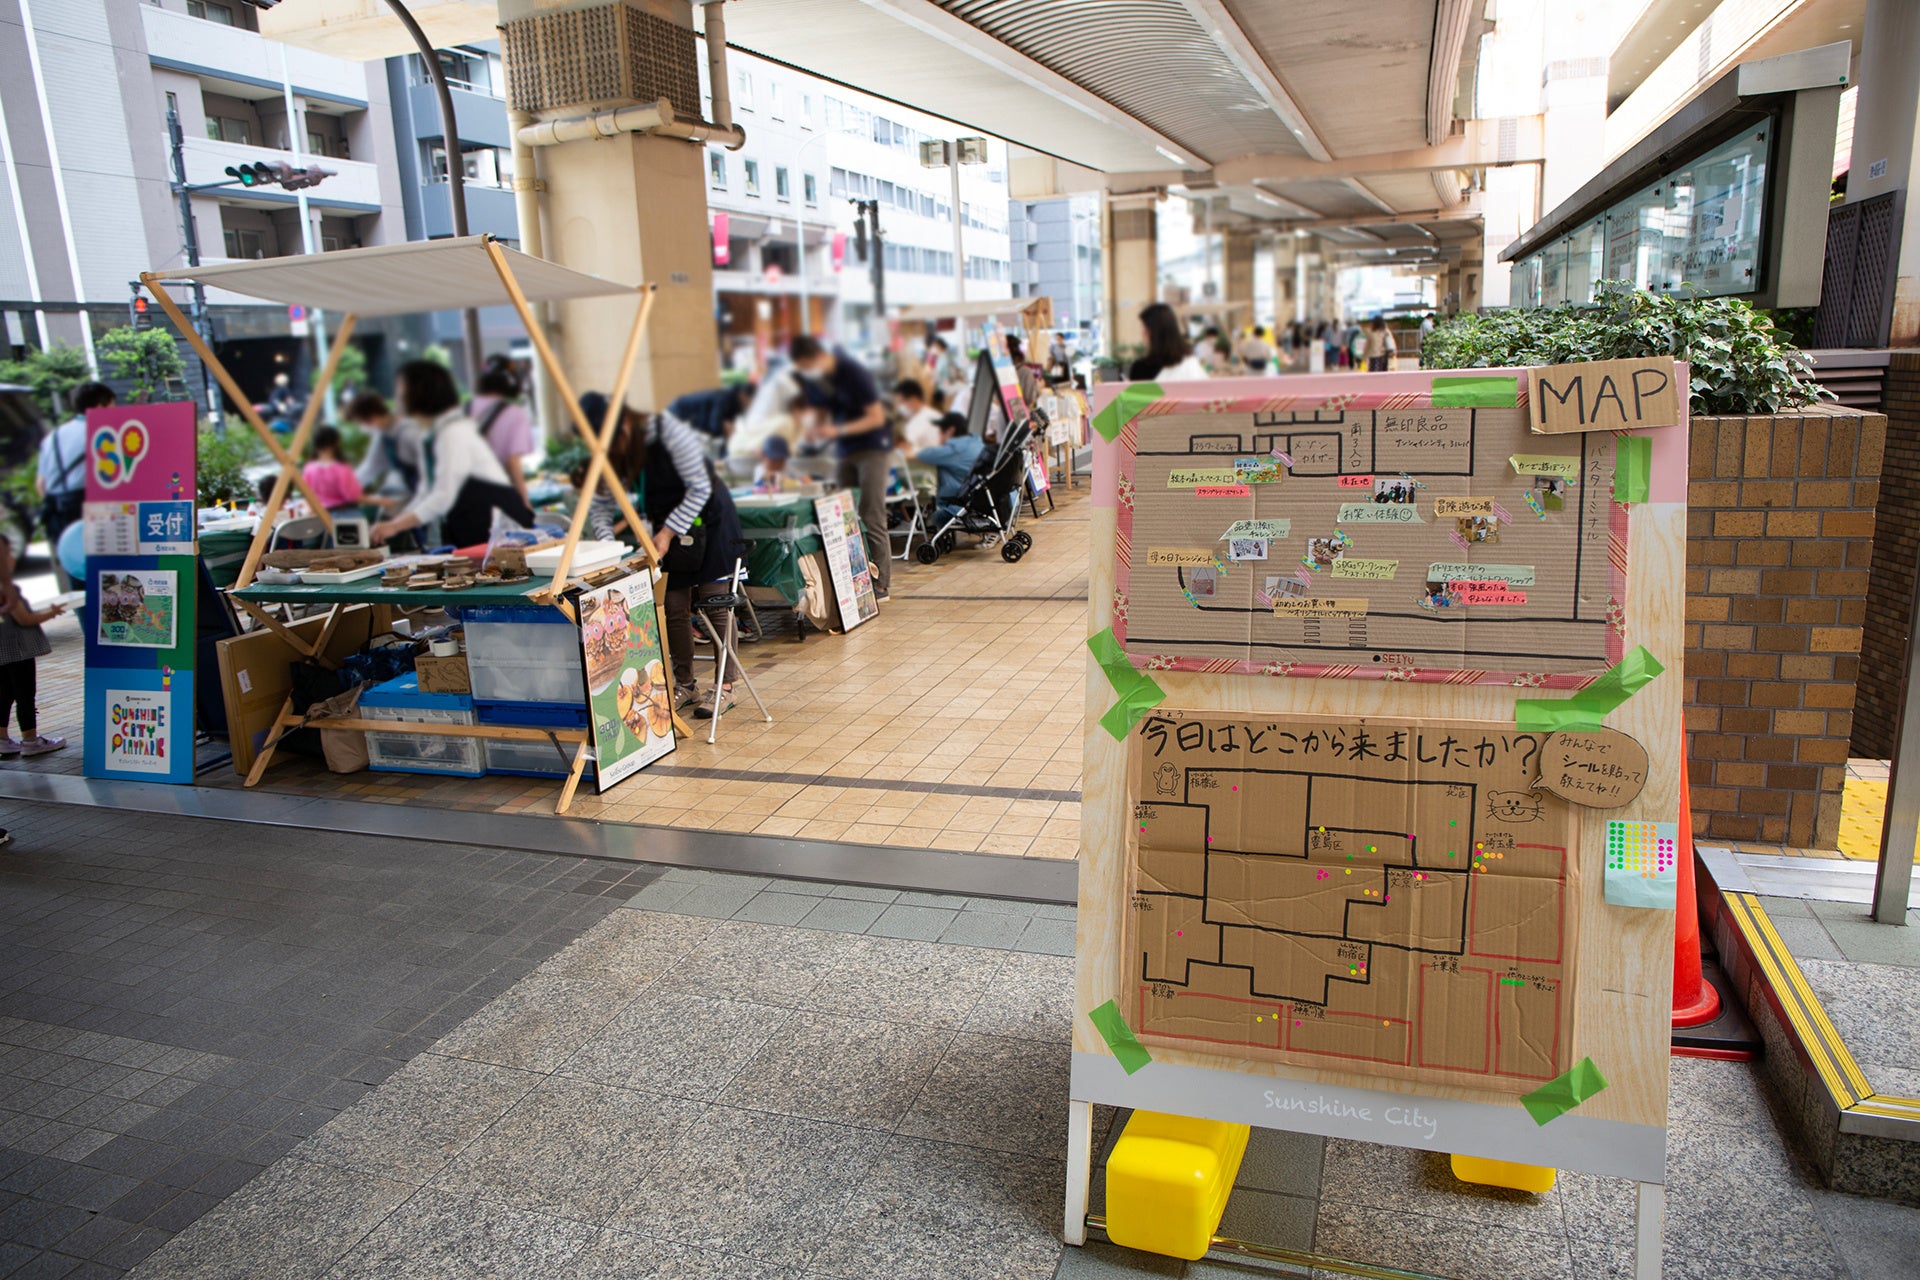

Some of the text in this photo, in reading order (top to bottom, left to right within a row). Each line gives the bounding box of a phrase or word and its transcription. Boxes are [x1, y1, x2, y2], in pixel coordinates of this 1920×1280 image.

[1539, 368, 1669, 424] MAP
[1384, 415, 1448, 433] 無印良品
[1302, 454, 1335, 464] カイザー
[1340, 478, 1370, 486] 現在地
[1586, 445, 1607, 541] バスターミナル
[1438, 499, 1493, 513] 冒険遊び場
[1343, 508, 1398, 521] お笑い体験
[147, 512, 183, 536] 受付
[1149, 551, 1213, 564] 母の日アレンジメント
[110, 625, 129, 634] 300
[1382, 653, 1415, 665] SEIYU
[112, 703, 165, 727] SUNSHINE
[121, 722, 155, 738] CITY
[599, 717, 620, 735] 300
[1139, 716, 1538, 776] 今日はどこから来ましたか?
[1559, 733, 1612, 754] みんなで
[1562, 754, 1642, 784] シールを貼って
[1190, 777, 1220, 789] 板橋区
[1559, 773, 1621, 797] 教えてね!!
[1446, 790, 1468, 798] 北区
[1311, 835, 1344, 850] 豊島区
[1485, 837, 1516, 849] 埼玉県
[1390, 877, 1424, 890] 文京区
[1337, 947, 1367, 961] 新宿区
[1430, 961, 1460, 974] 千葉県
[1263, 1089, 1438, 1140] Sunshine City
